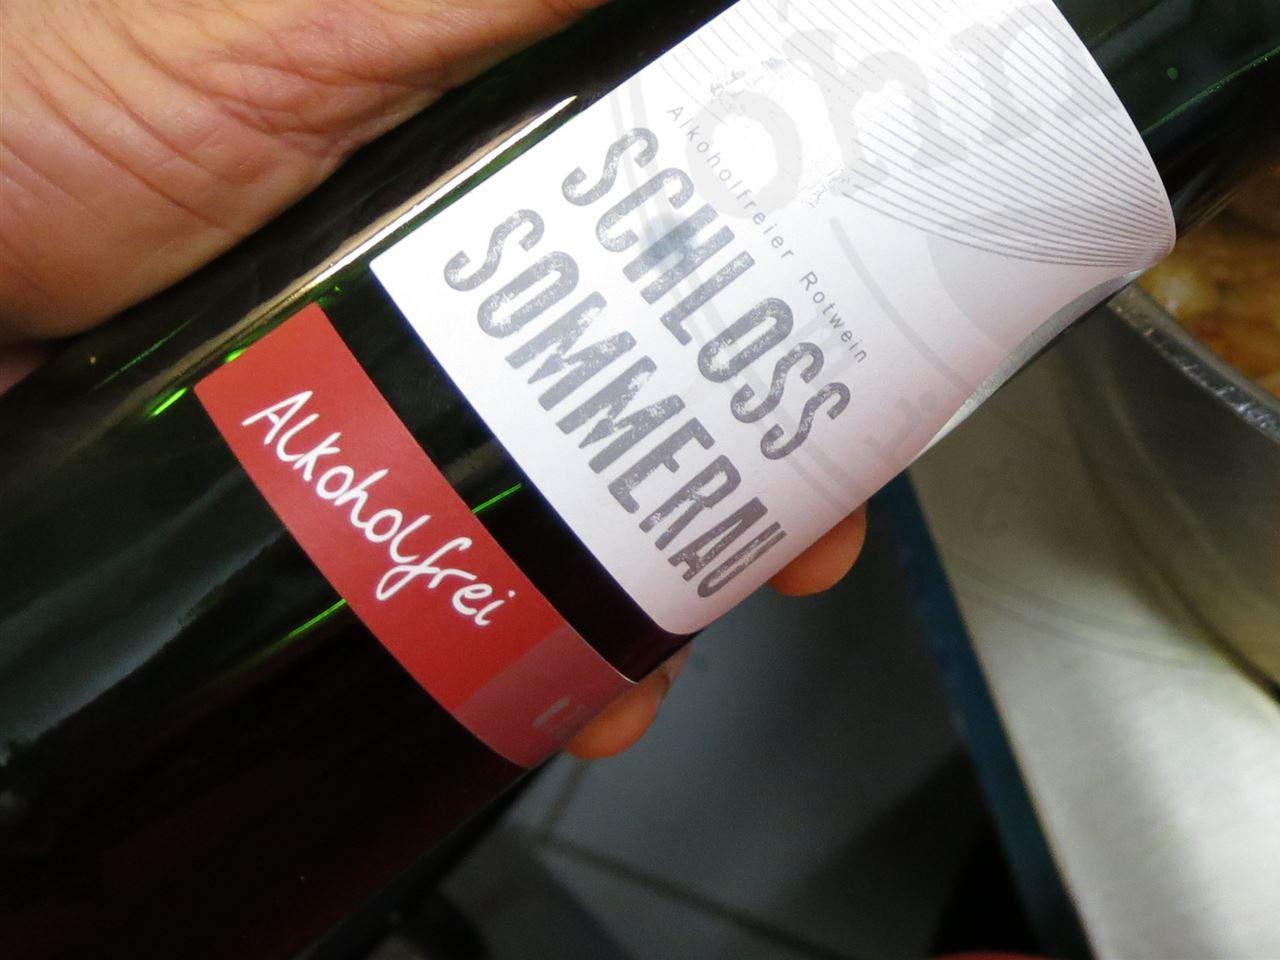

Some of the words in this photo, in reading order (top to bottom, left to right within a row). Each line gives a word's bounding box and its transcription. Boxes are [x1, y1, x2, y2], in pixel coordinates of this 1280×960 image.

[561, 126, 851, 461] SCHLOSS
[666, 105, 794, 259] Alkoholfreier
[799, 271, 867, 363] Rotwein
[242, 391, 516, 626] Alkoholfrei
[443, 208, 787, 599] SOMMERAU
